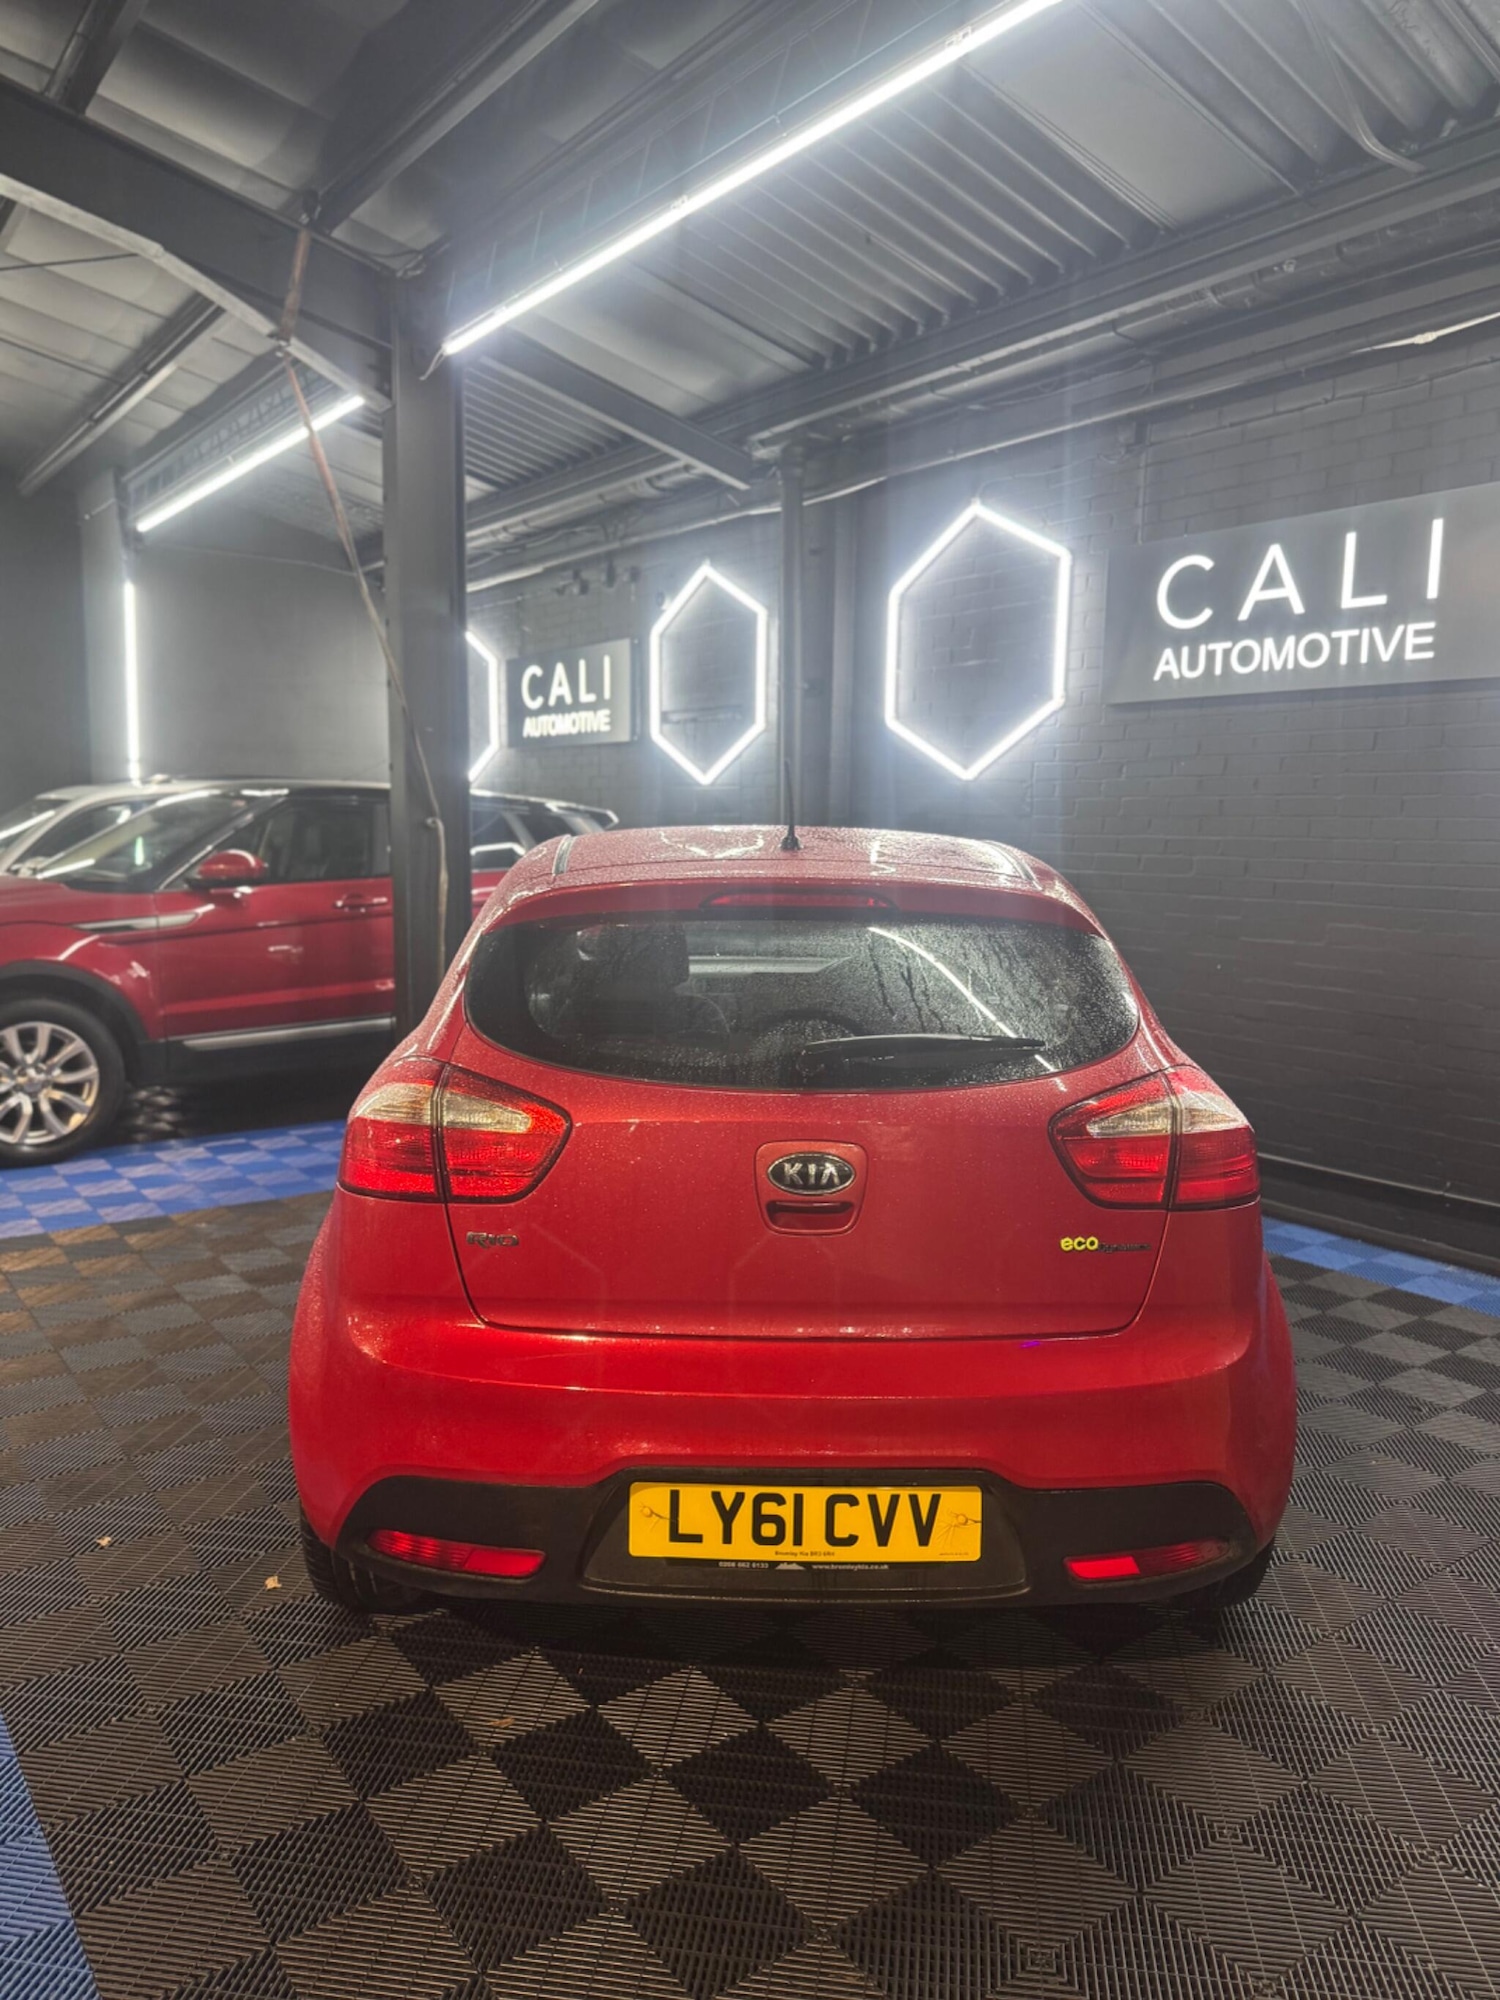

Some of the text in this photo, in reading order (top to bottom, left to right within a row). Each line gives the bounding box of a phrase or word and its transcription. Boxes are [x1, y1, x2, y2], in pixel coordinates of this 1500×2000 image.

[1156, 517, 1444, 630] CALI
[1153, 621, 1436, 682] AUTOMOTIVE
[521, 654, 611, 710] CALI
[522, 708, 611, 738] AUTOMOTIVE
[783, 1162, 840, 1185] KIA
[669, 1489, 941, 1547] LY61 CVV
